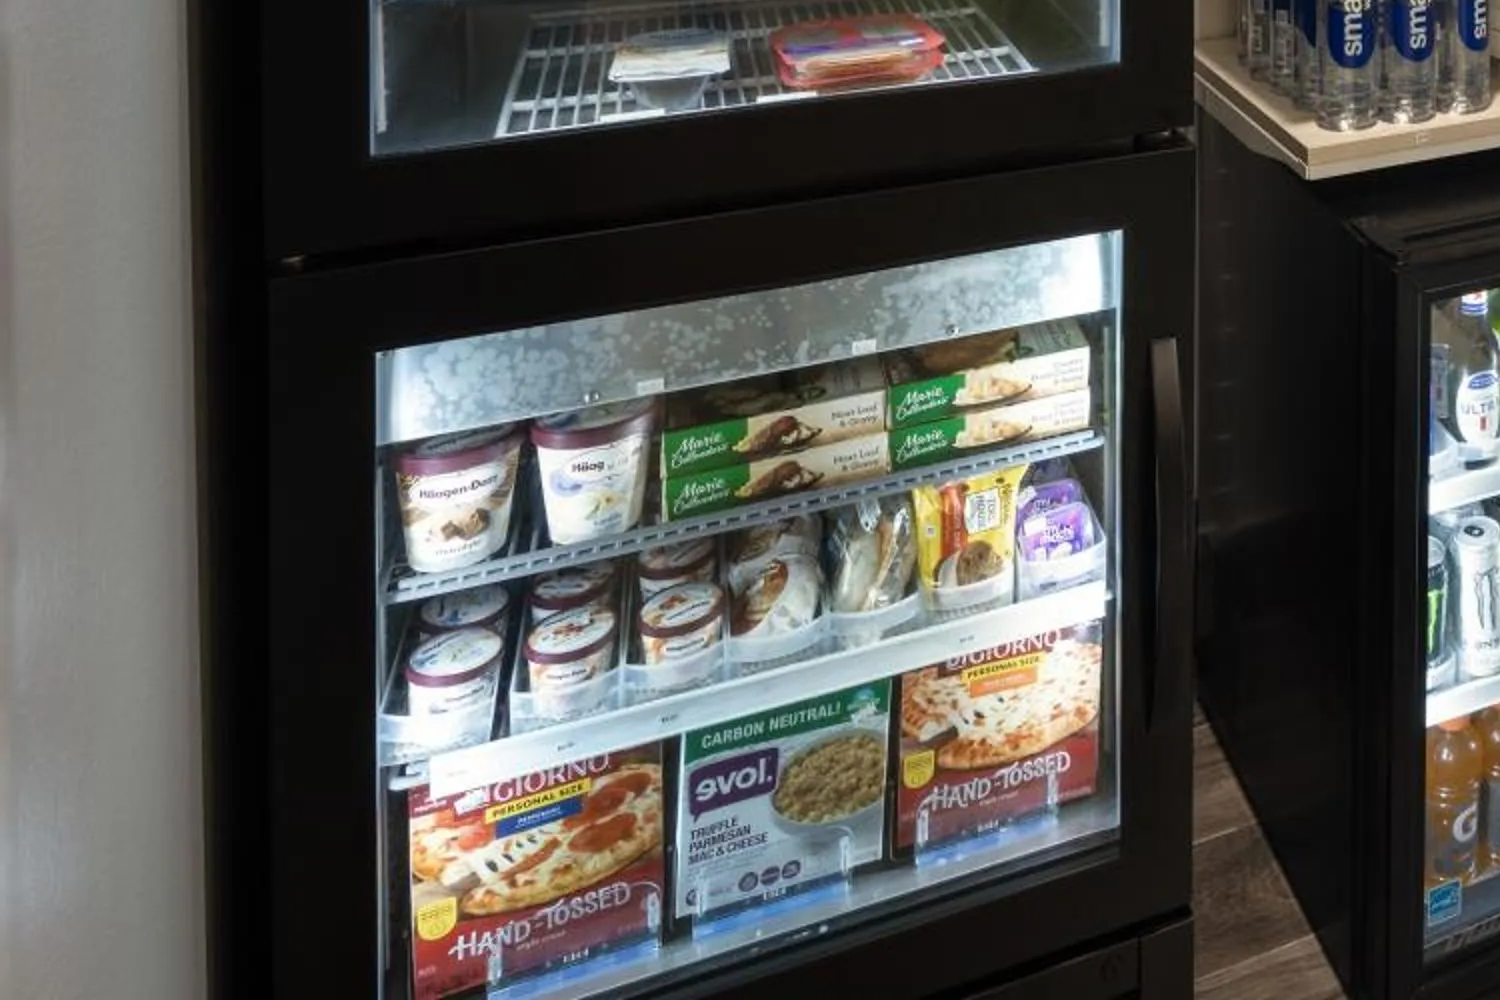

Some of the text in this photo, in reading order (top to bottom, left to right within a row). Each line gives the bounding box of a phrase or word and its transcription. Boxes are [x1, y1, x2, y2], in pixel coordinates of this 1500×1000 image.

[904, 387, 944, 408] Marie
[857, 404, 878, 415] Loaf
[847, 415, 879, 428] Gravy
[679, 432, 723, 454] Marie
[904, 430, 945, 449] Marie
[858, 448, 880, 460] Loaf
[681, 477, 725, 499] Marie
[967, 660, 1019, 679] PERSONAL
[701, 701, 842, 749] CARBON NEUTRAL!
[491, 790, 557, 817] PERSONAL
[559, 782, 585, 797] SIZE
[691, 816, 739, 841] TRUFFLE
[1452, 802, 1478, 842] G
[688, 832, 769, 866] MAC & CHEESE
[689, 824, 752, 853] PARMESAN
[448, 882, 632, 961] HAND-TOSSED
